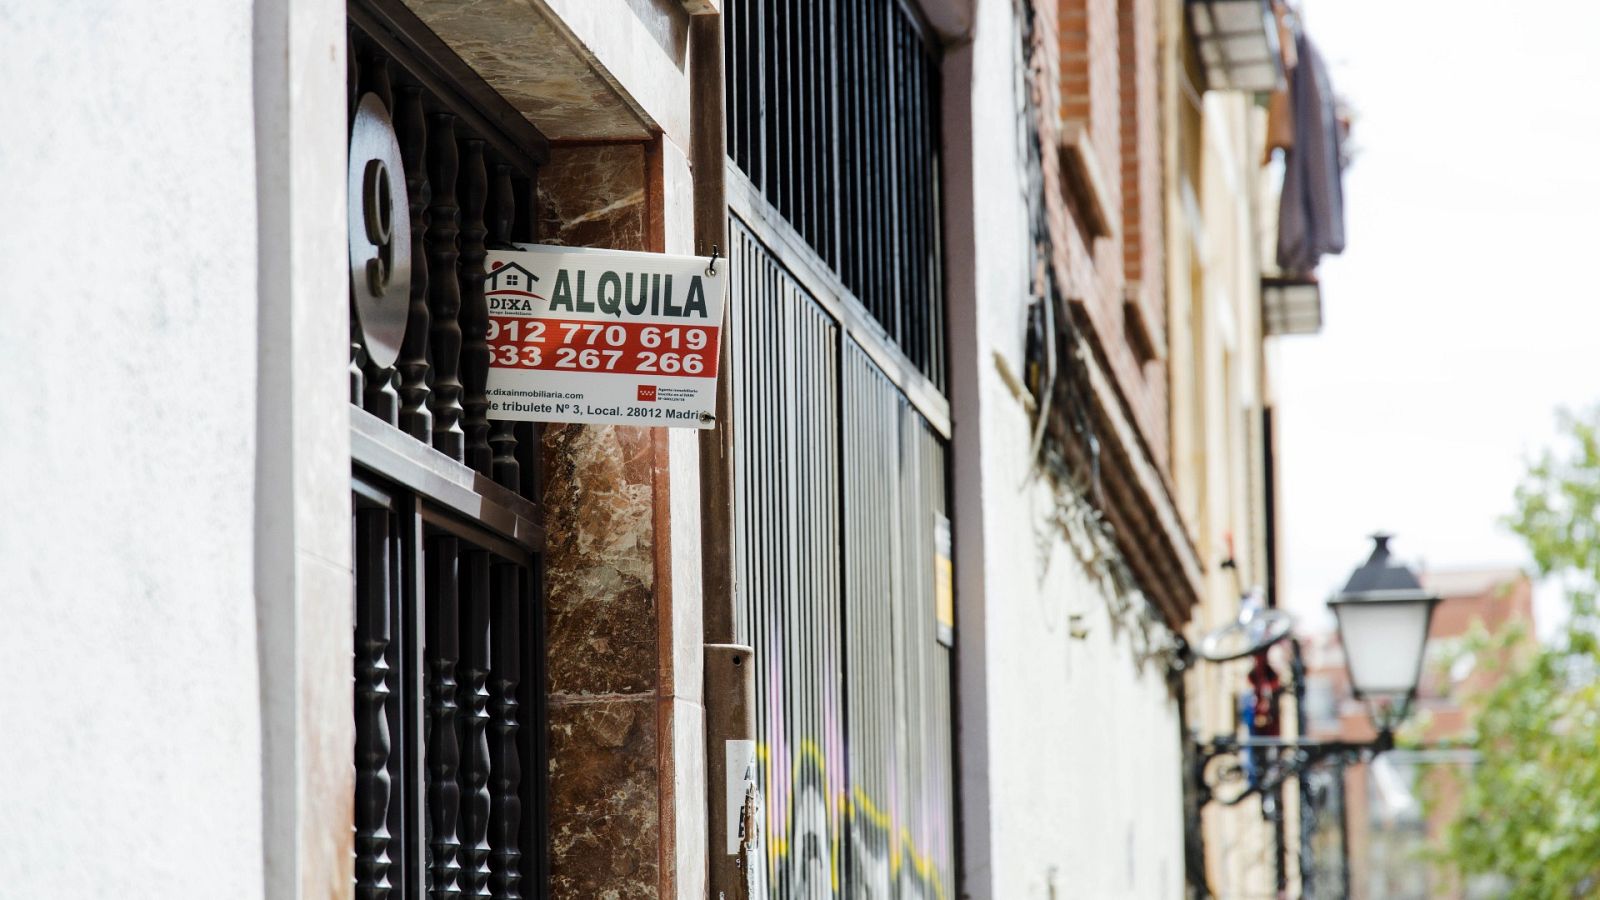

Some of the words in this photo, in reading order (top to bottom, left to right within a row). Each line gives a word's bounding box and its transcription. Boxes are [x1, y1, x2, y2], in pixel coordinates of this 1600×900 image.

[362, 159, 395, 298] 9
[549, 269, 708, 319] ALQUILA
[485, 319, 546, 343] 912
[559, 323, 627, 347] 770
[639, 327, 708, 350] 619
[554, 348, 624, 370] 267
[635, 352, 704, 374] 266
[502, 401, 552, 413] tribulete
[573, 405, 583, 416] 3,
[587, 405, 623, 417] Local.
[627, 407, 662, 418] 28012
[665, 408, 699, 420] Madri
